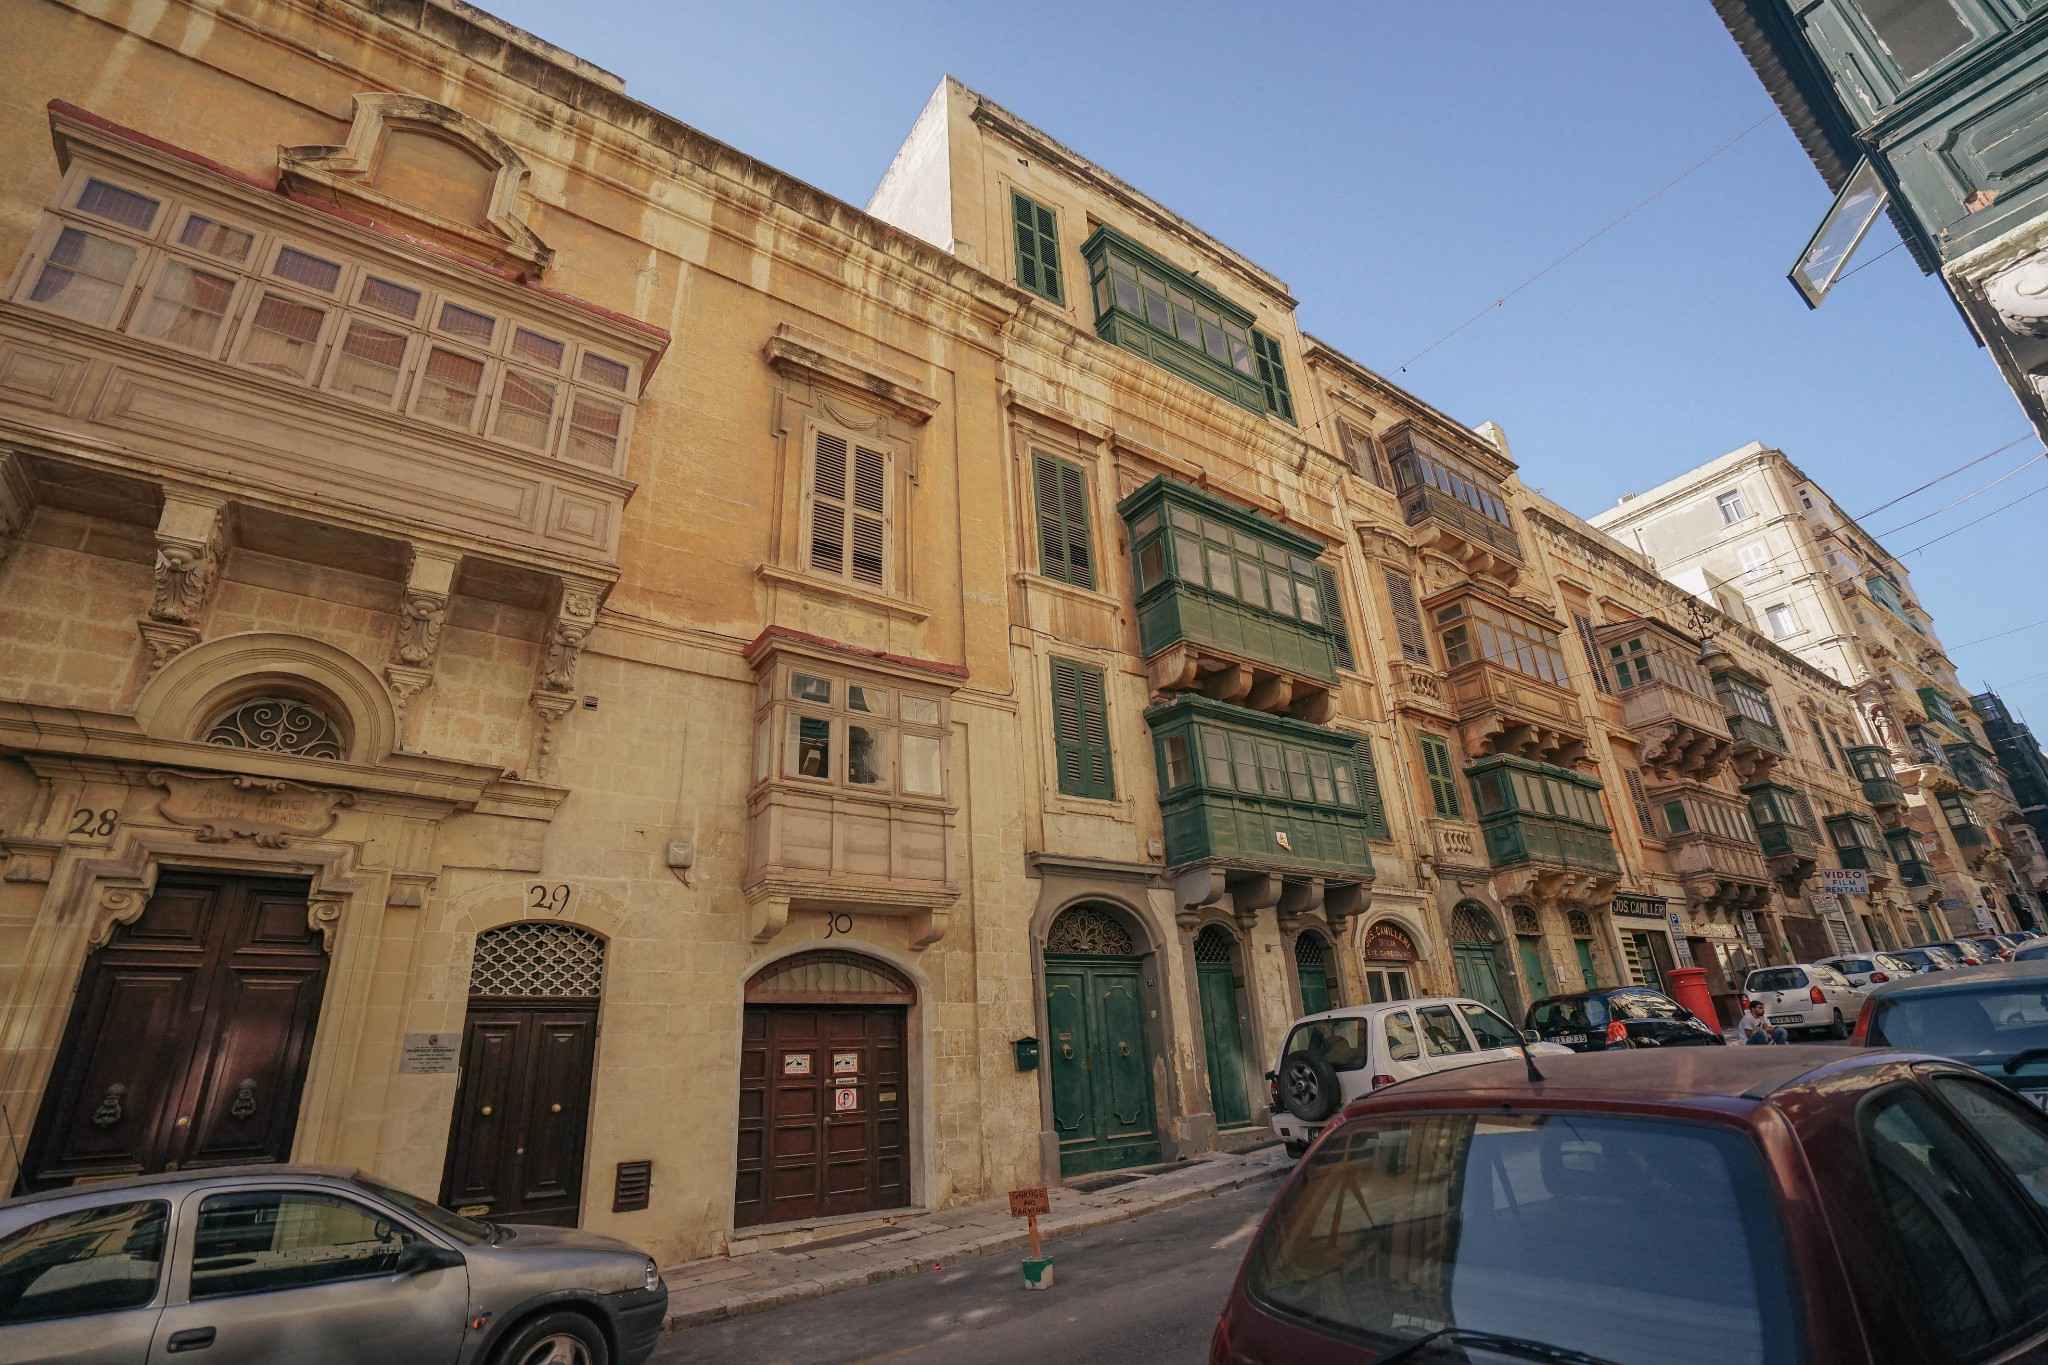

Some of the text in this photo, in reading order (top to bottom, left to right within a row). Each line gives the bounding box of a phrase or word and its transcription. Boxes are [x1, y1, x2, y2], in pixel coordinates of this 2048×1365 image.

[70, 808, 118, 837] 28
[528, 884, 570, 917] 29
[823, 911, 853, 939] 30
